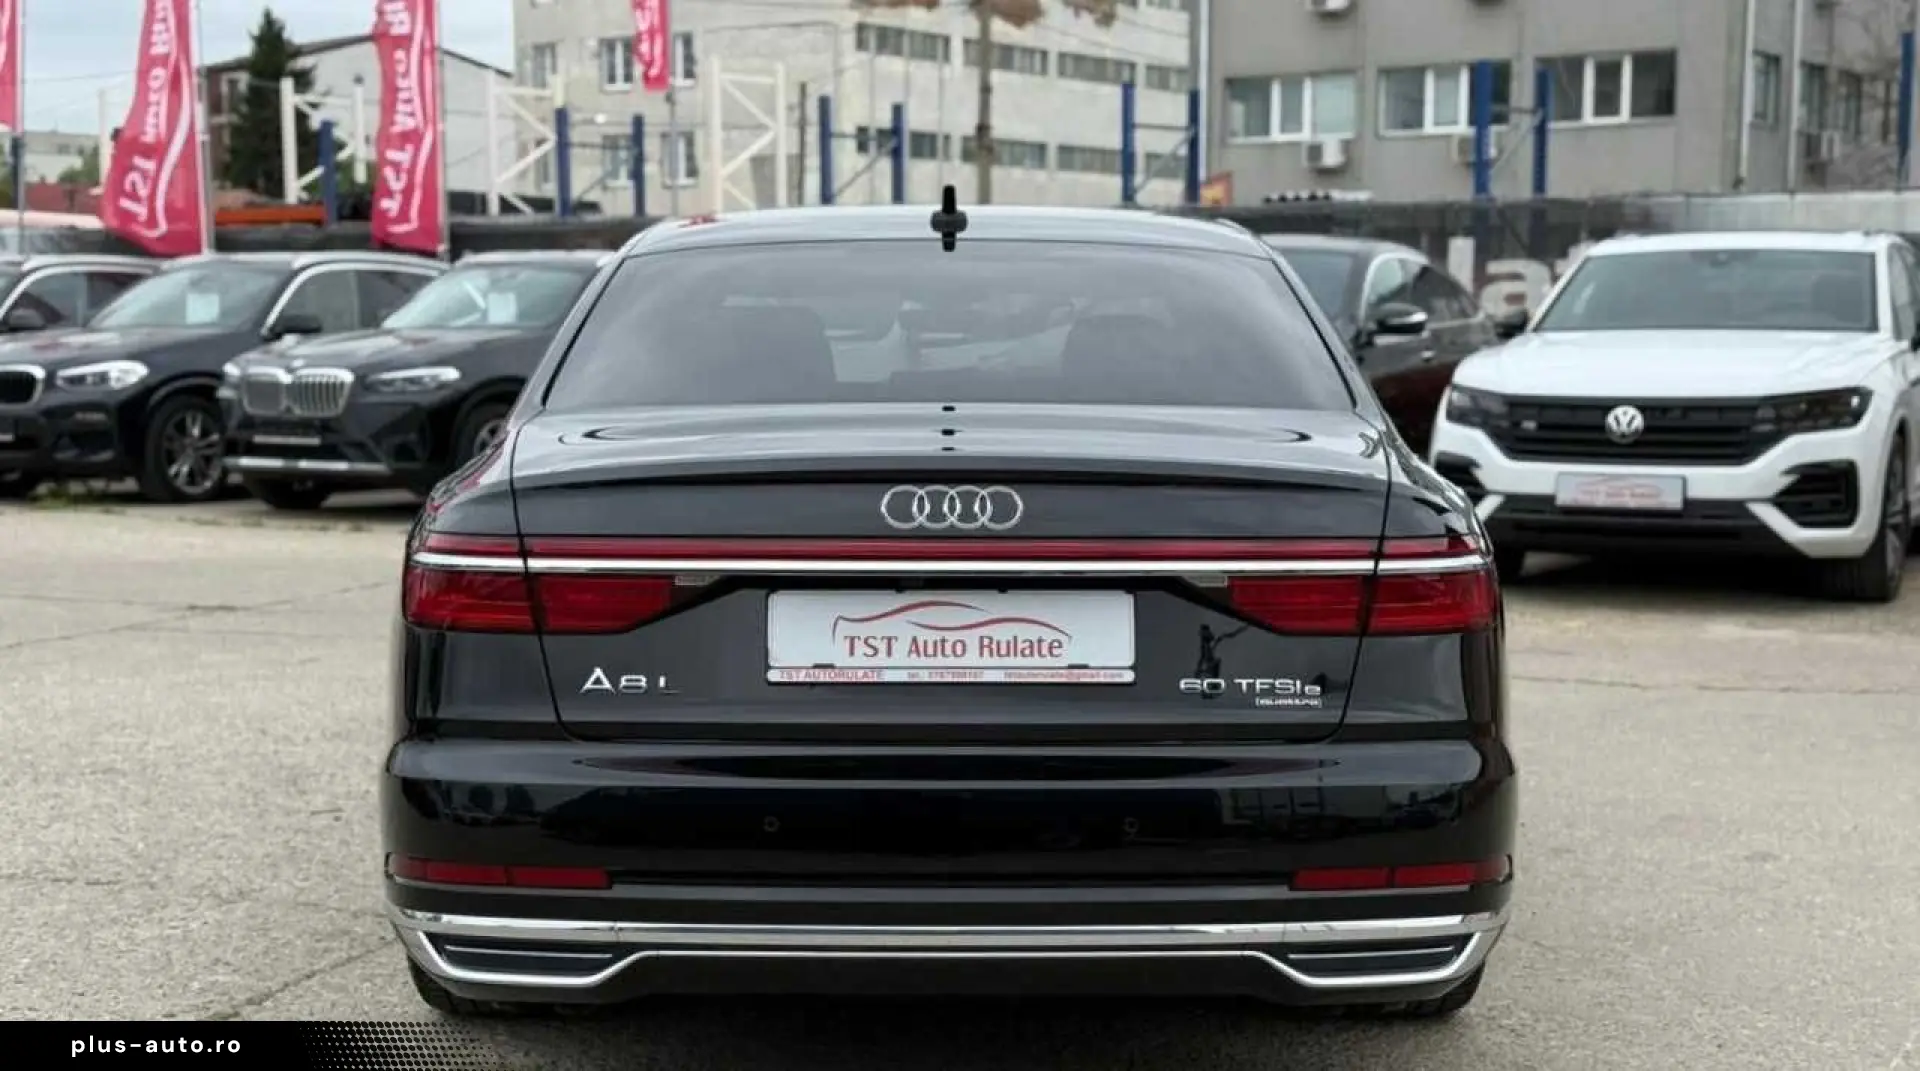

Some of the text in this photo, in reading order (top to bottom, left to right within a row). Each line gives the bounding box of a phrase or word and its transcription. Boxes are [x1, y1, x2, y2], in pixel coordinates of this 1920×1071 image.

[843, 635, 1064, 659] TST Auto Rulate
[579, 666, 648, 694] A8
[1178, 677, 1225, 694] 60
